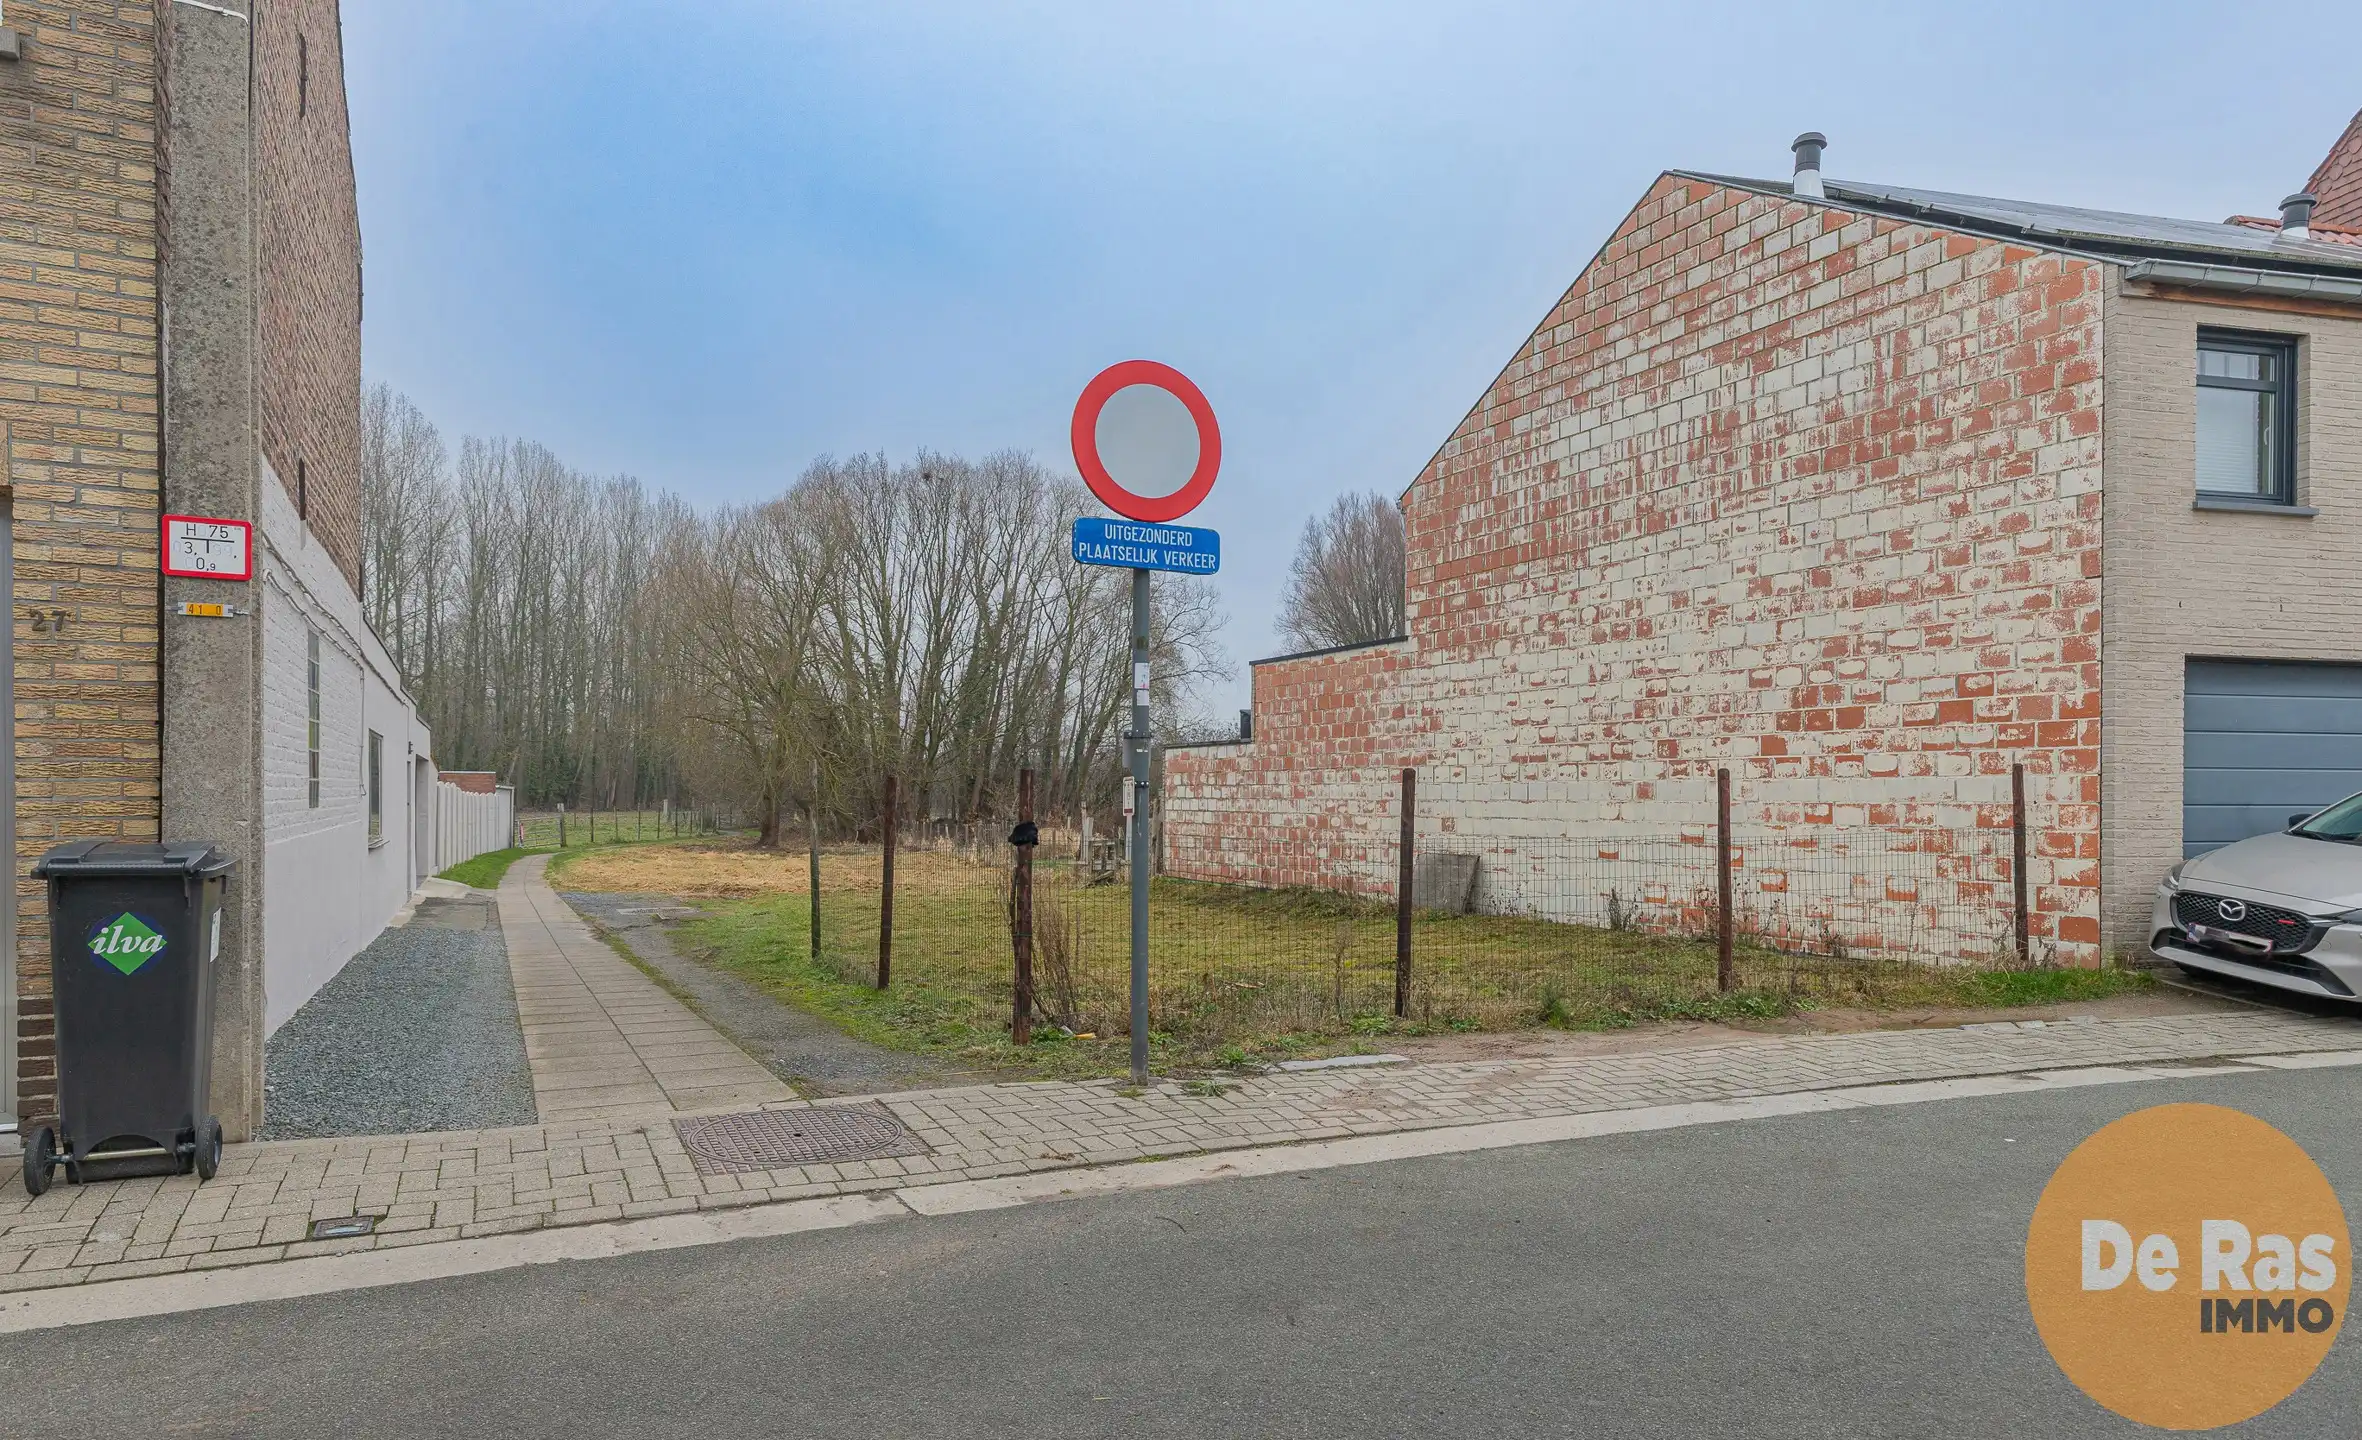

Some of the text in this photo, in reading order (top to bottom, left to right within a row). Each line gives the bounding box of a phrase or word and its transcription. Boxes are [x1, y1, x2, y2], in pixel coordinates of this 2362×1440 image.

[186, 523, 229, 539] H 75
[1105, 523, 1192, 547] UITGEZONDERD
[196, 557, 216, 571] 0,9
[1079, 542, 1216, 569] PLAATSELIJK VERKEER
[29, 609, 70, 632] 27
[93, 925, 164, 955] ilva
